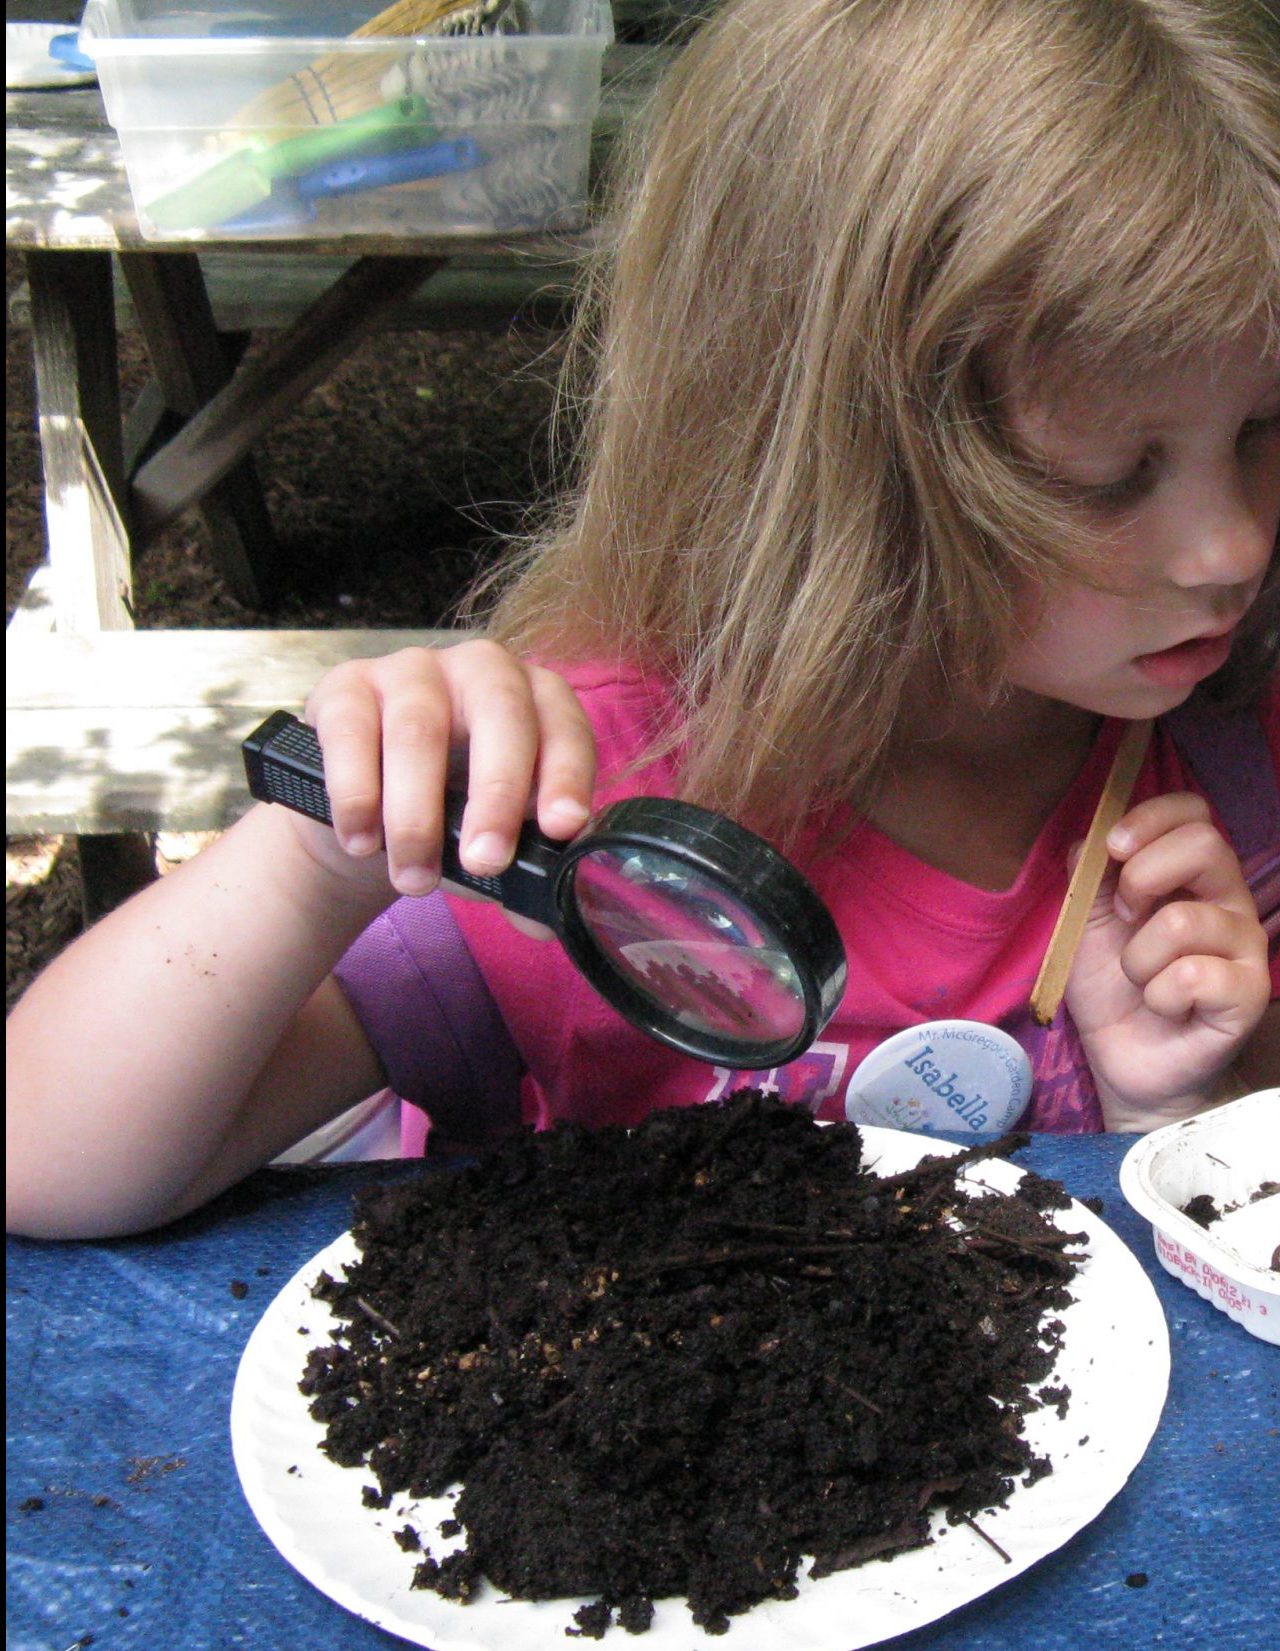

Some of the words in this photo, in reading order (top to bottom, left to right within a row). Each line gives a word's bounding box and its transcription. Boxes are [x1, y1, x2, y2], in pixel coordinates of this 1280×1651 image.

[918, 1029, 940, 1042] Mr.
[904, 1045, 988, 1131] Isabella
[1005, 1056, 1025, 1096] Garden
[996, 1098, 1022, 1129] Camp
